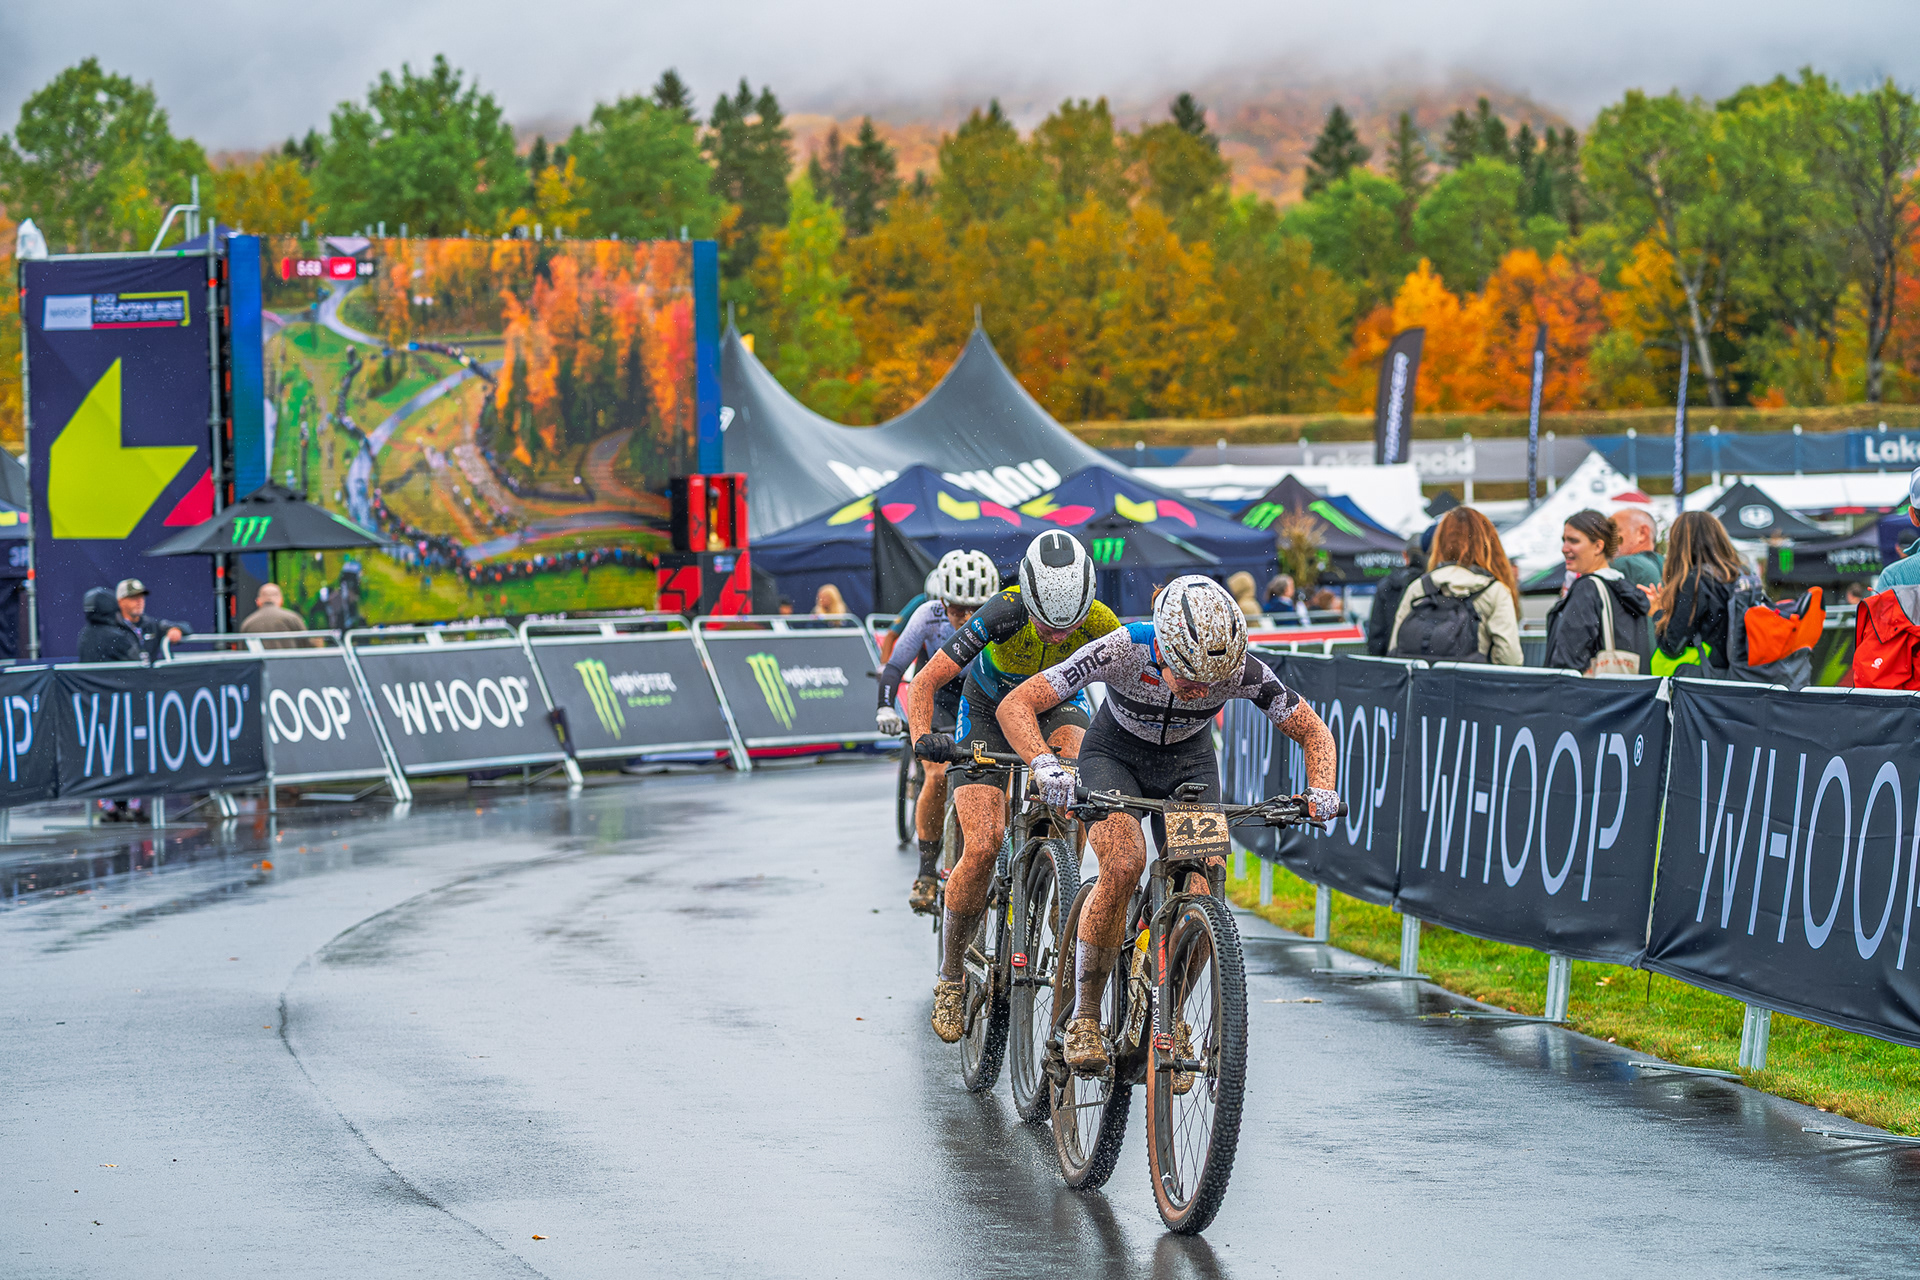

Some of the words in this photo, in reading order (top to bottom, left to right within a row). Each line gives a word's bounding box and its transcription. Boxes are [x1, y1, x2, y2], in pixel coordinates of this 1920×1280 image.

[1063, 644, 1112, 688] BMC
[269, 687, 350, 744] OOP
[1177, 818, 1219, 840] 42
